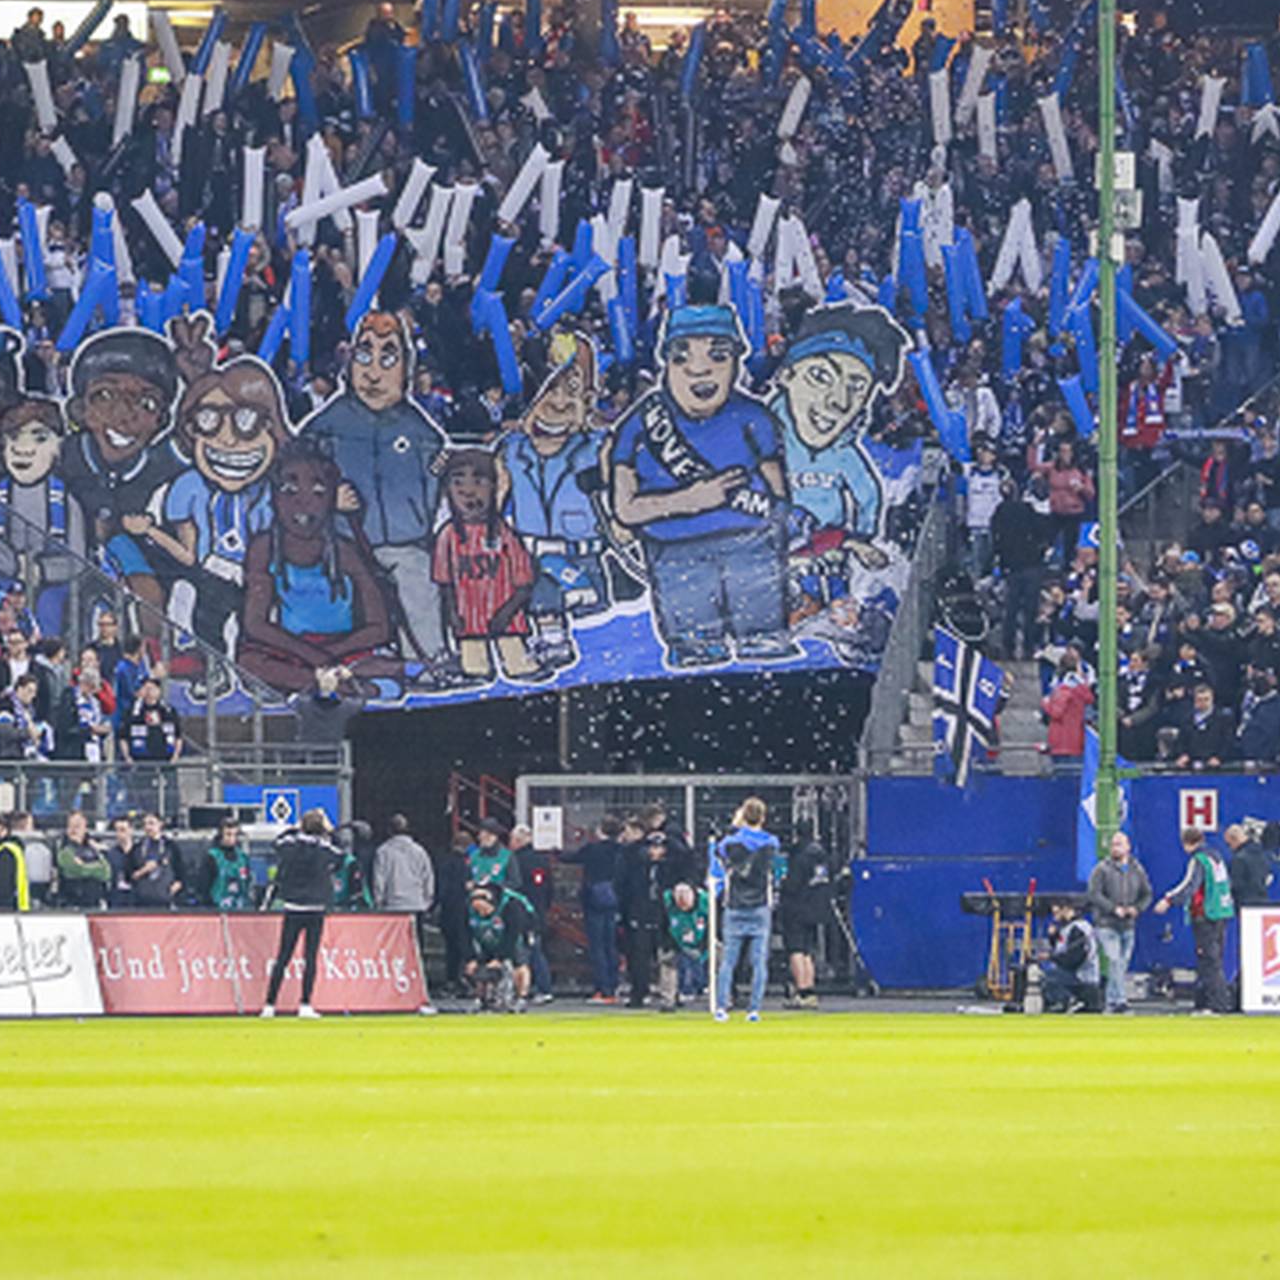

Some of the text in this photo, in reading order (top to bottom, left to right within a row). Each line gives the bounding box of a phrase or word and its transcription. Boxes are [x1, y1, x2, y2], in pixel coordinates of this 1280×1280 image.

[1186, 795, 1212, 826] H
[100, 947, 166, 981] Und
[178, 947, 253, 992] jetzt
[320, 947, 416, 995] König.
